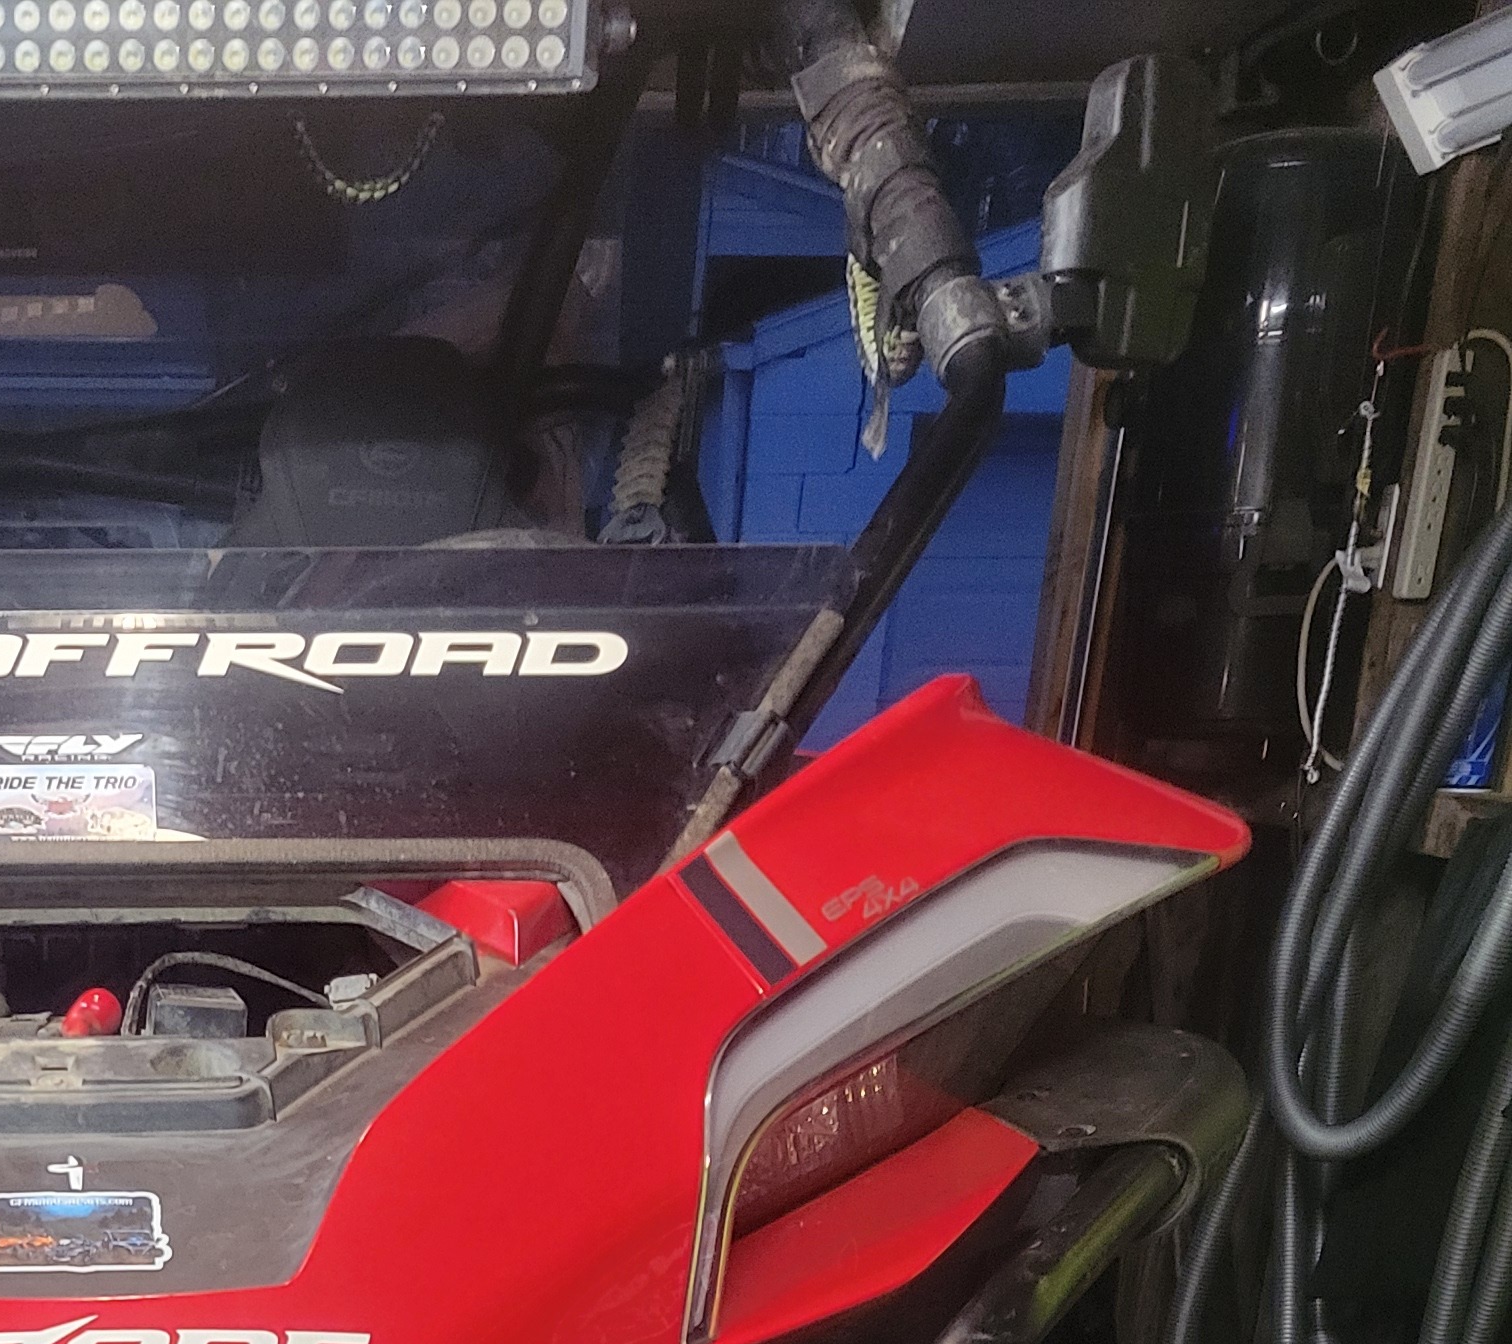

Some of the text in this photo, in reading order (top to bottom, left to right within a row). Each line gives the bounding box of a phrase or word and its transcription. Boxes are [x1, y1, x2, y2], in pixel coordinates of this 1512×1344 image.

[45, 775, 85, 790] THE
[93, 775, 137, 790] TRIO
[821, 875, 885, 922] EPS
